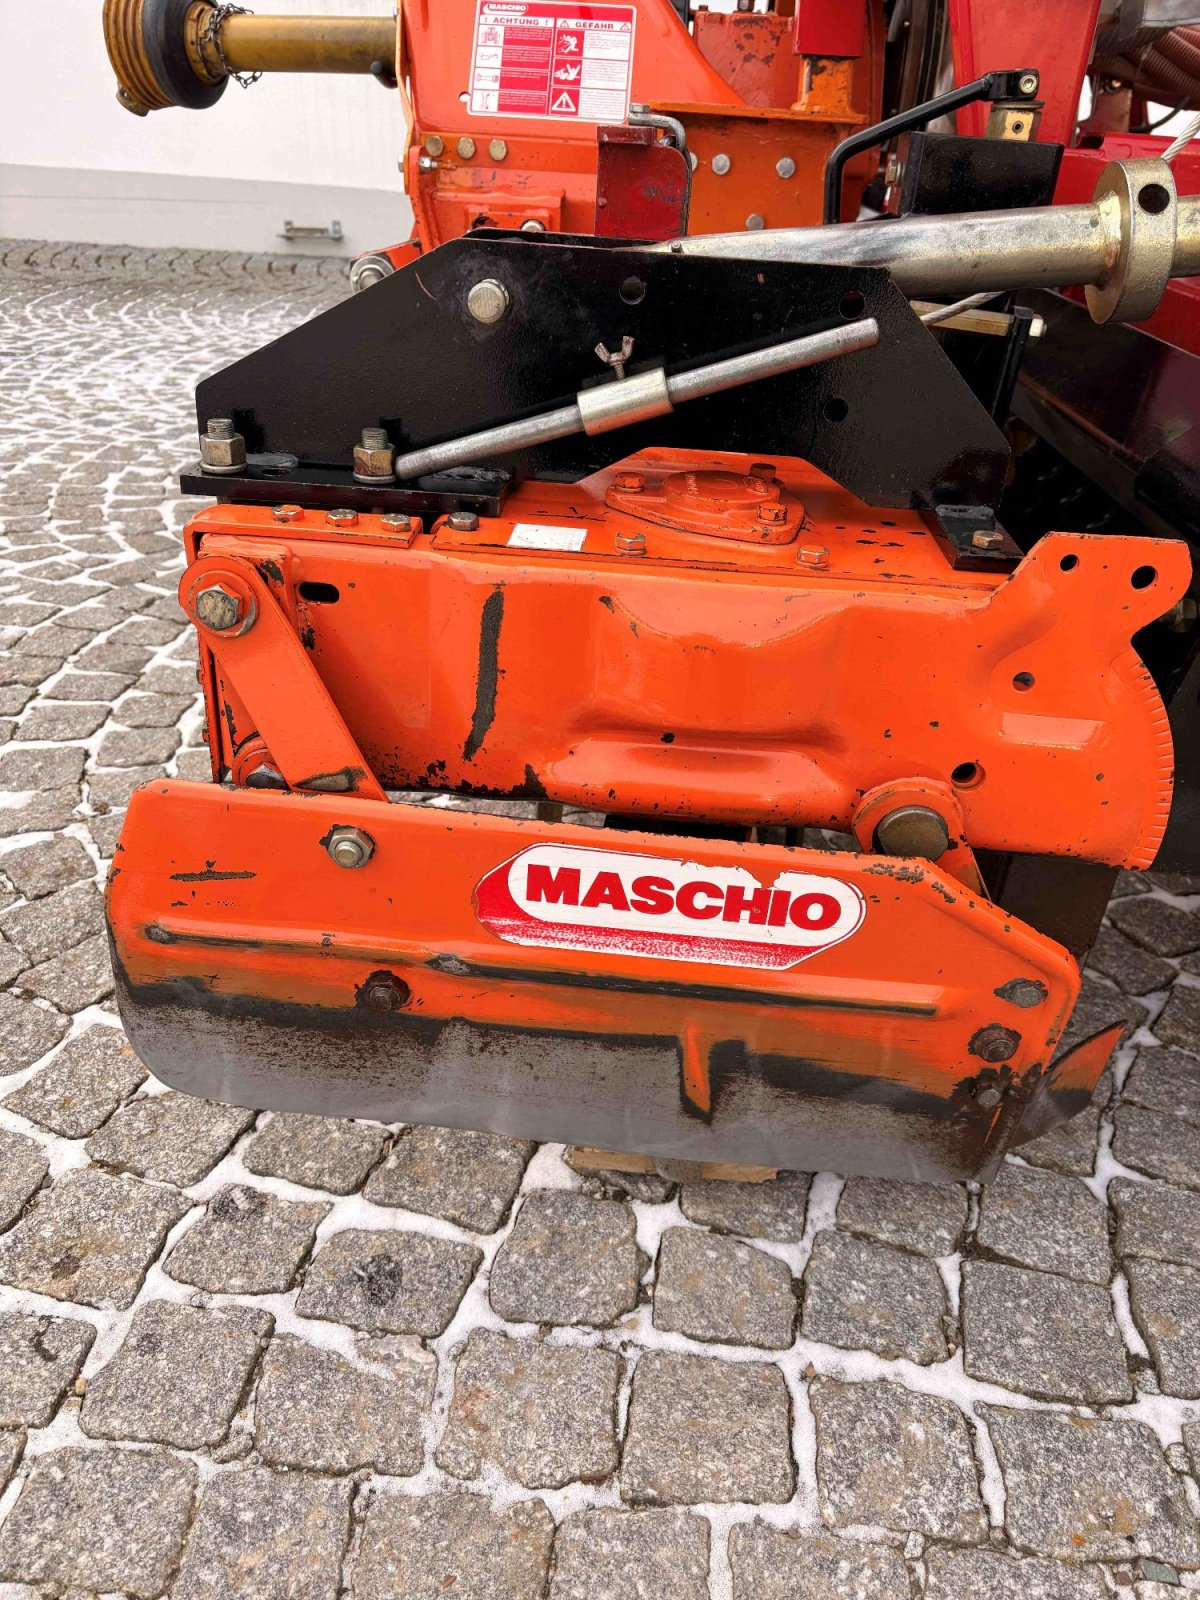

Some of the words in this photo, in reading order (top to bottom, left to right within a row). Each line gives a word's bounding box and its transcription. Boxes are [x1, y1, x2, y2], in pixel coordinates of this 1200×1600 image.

[489, 3, 526, 11] MASCHIO
[493, 17, 539, 26] ACHTUNG
[575, 21, 614, 30] GEFAHR
[526, 864, 842, 931] MASCHIO
